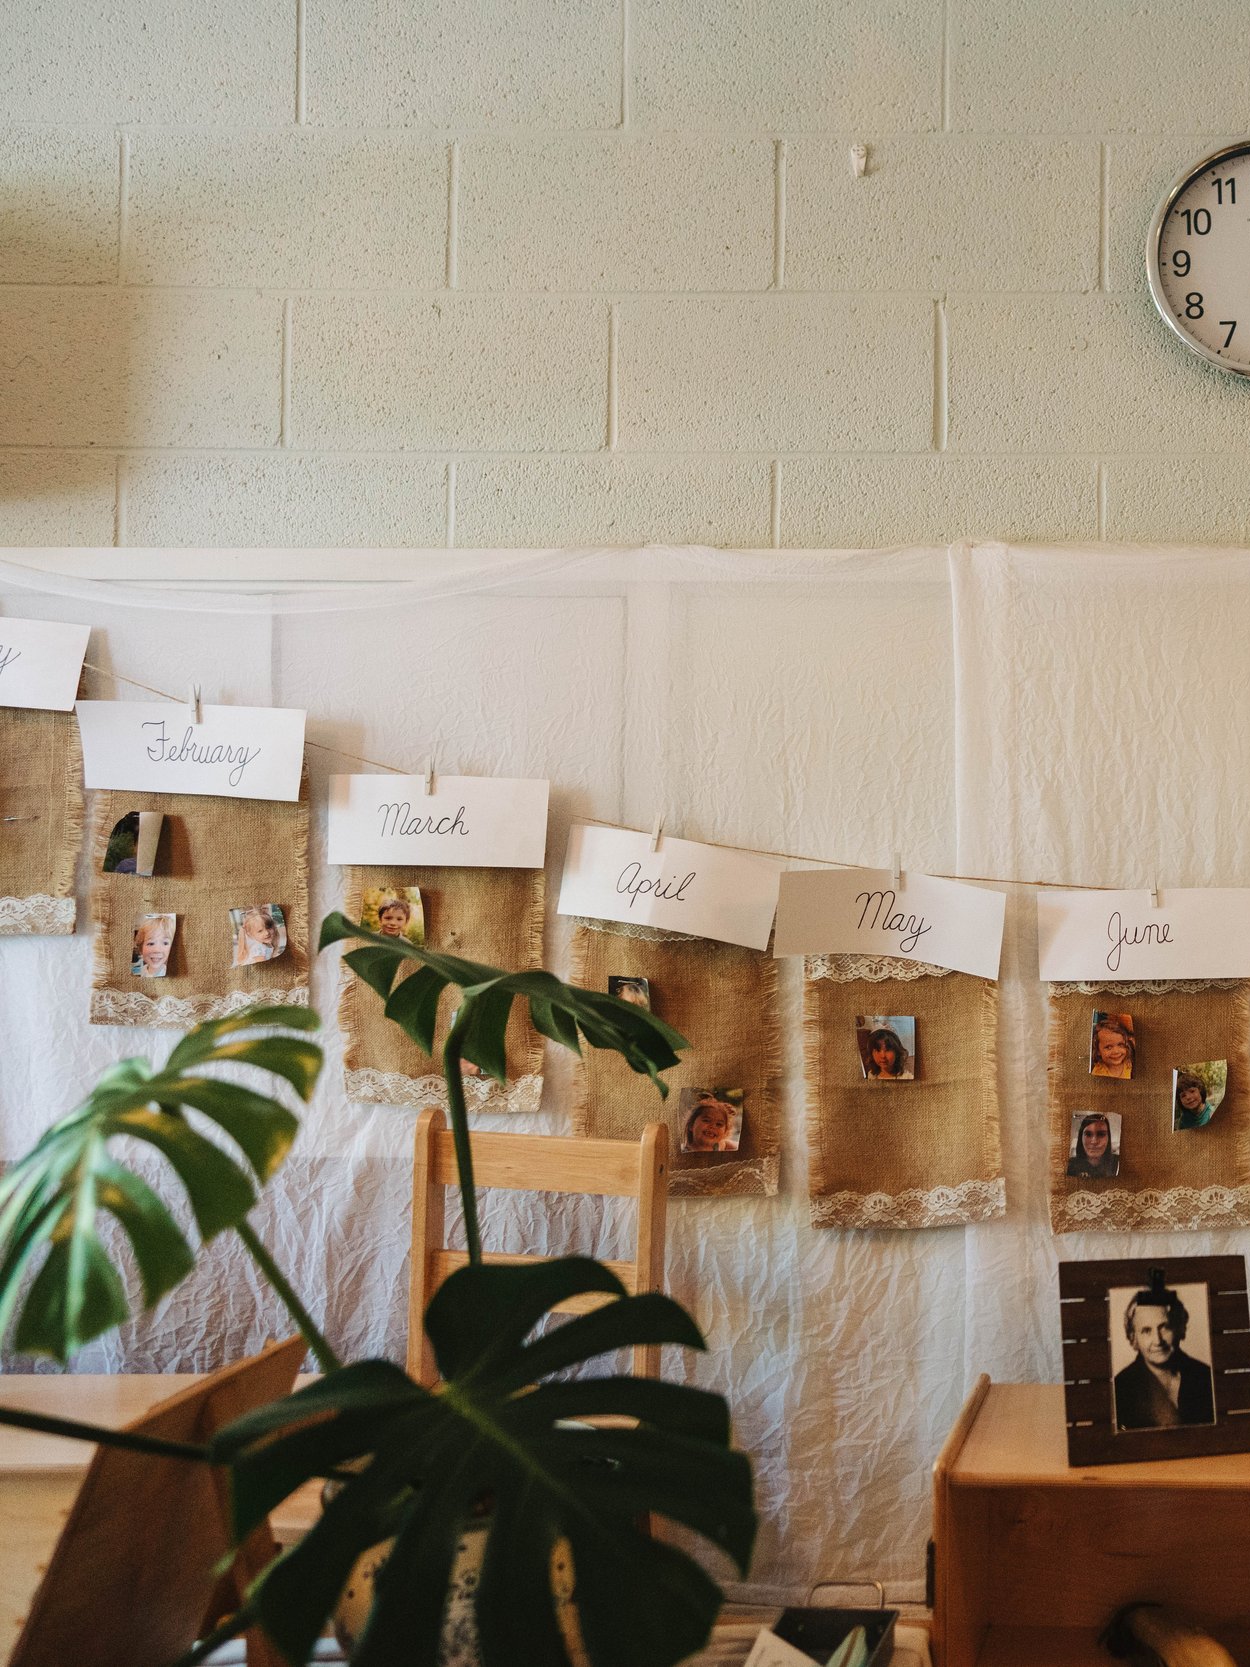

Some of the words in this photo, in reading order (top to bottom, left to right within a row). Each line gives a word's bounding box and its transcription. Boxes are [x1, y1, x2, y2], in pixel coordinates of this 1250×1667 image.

[1211, 177, 1236, 204] 11
[1180, 208, 1212, 235] 10
[1172, 250, 1191, 277] 9
[1185, 292, 1204, 319] 8
[1219, 321, 1237, 348] 7
[142, 720, 261, 786] February
[378, 802, 469, 837] March
[616, 862, 696, 908] April
[855, 890, 932, 953] May
[1107, 911, 1174, 971] June
